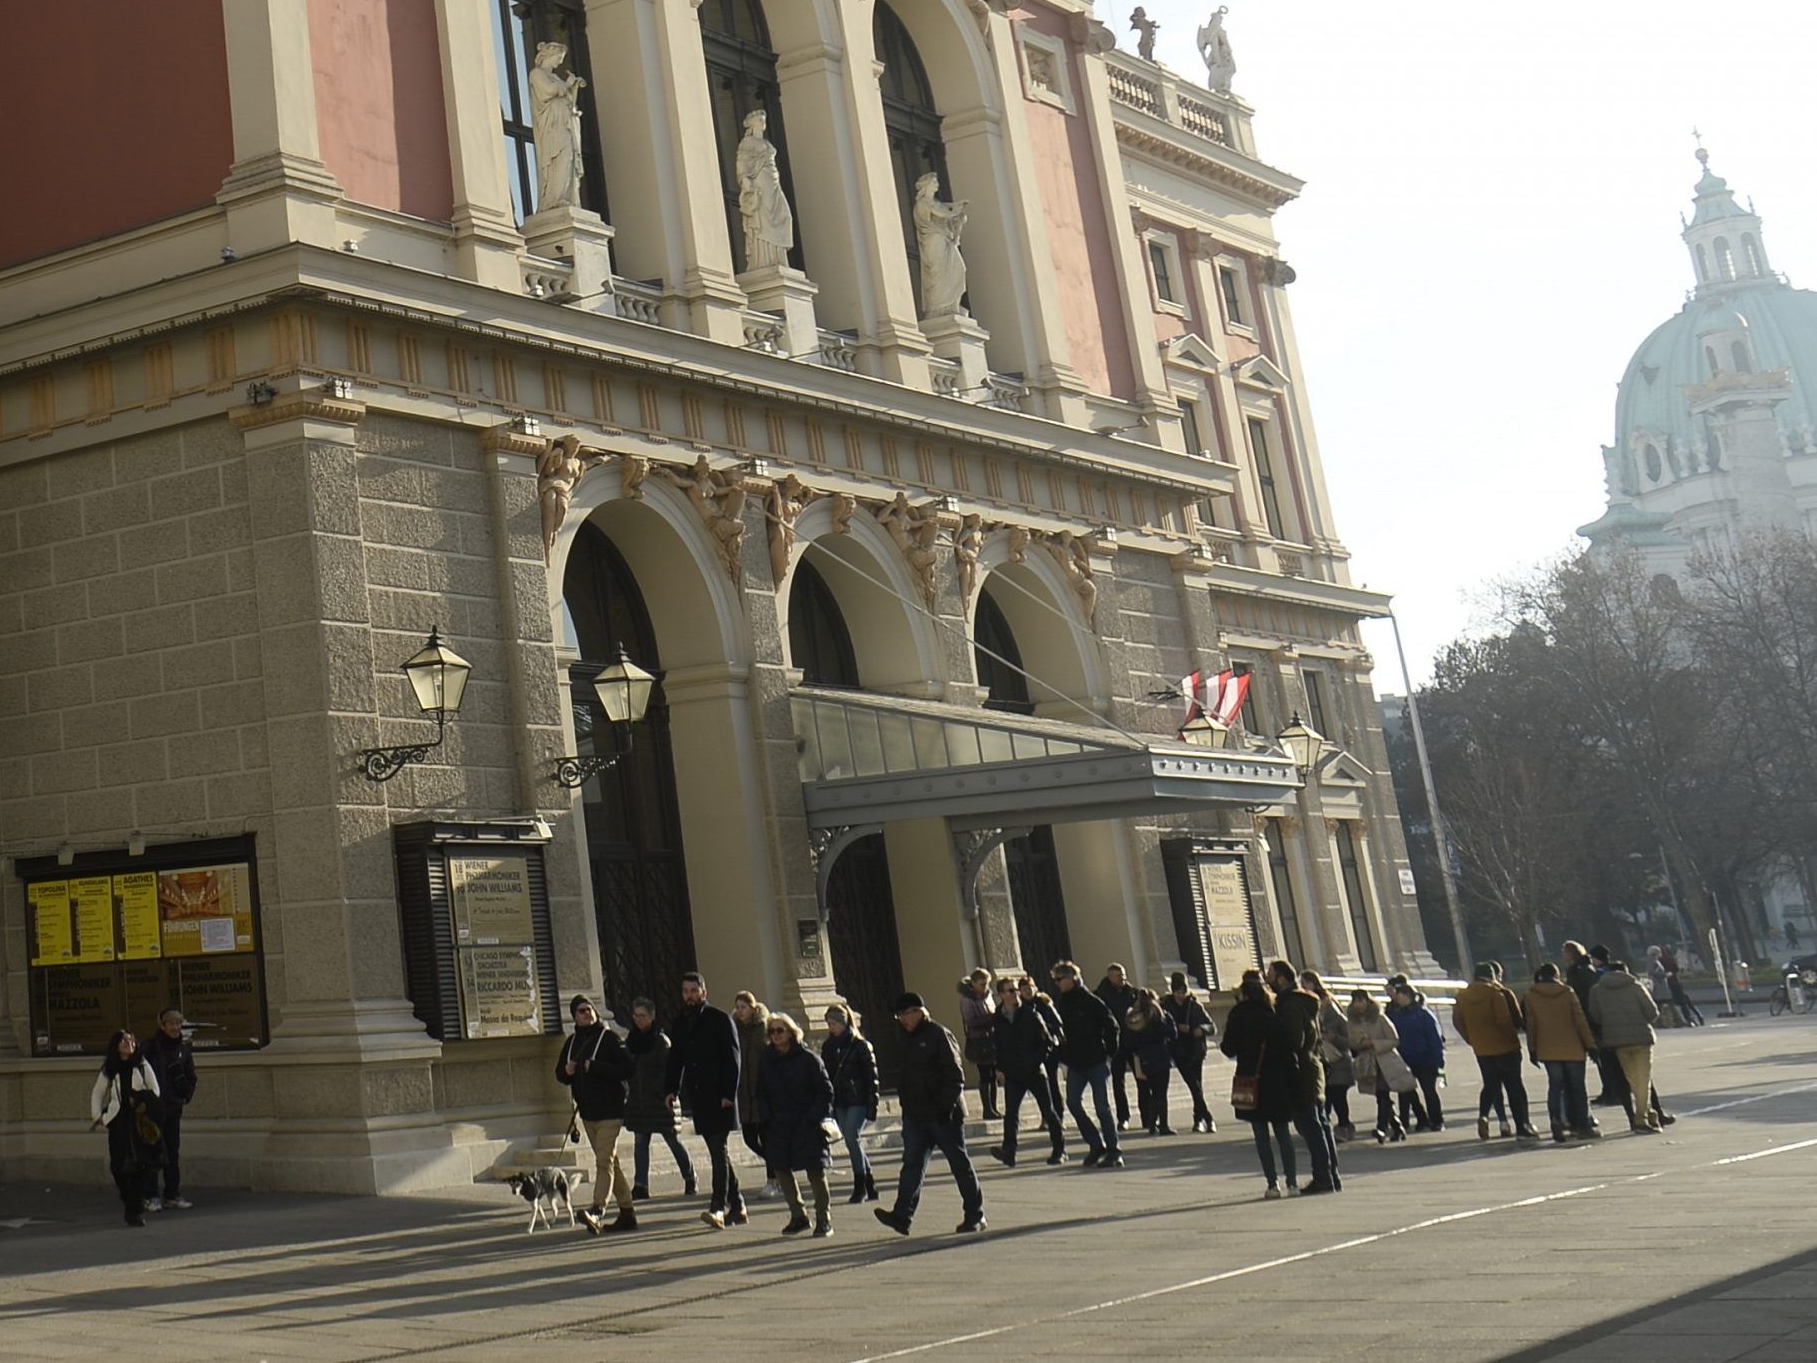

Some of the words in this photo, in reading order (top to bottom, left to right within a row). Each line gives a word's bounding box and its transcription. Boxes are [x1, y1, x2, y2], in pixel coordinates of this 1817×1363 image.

[468, 883, 487, 893] JOHN
[488, 883, 522, 893] WILLIAMS
[1218, 933, 1246, 950] KISSIN
[209, 982, 252, 994] WILLIAMS
[477, 981, 513, 991] RICCARDO
